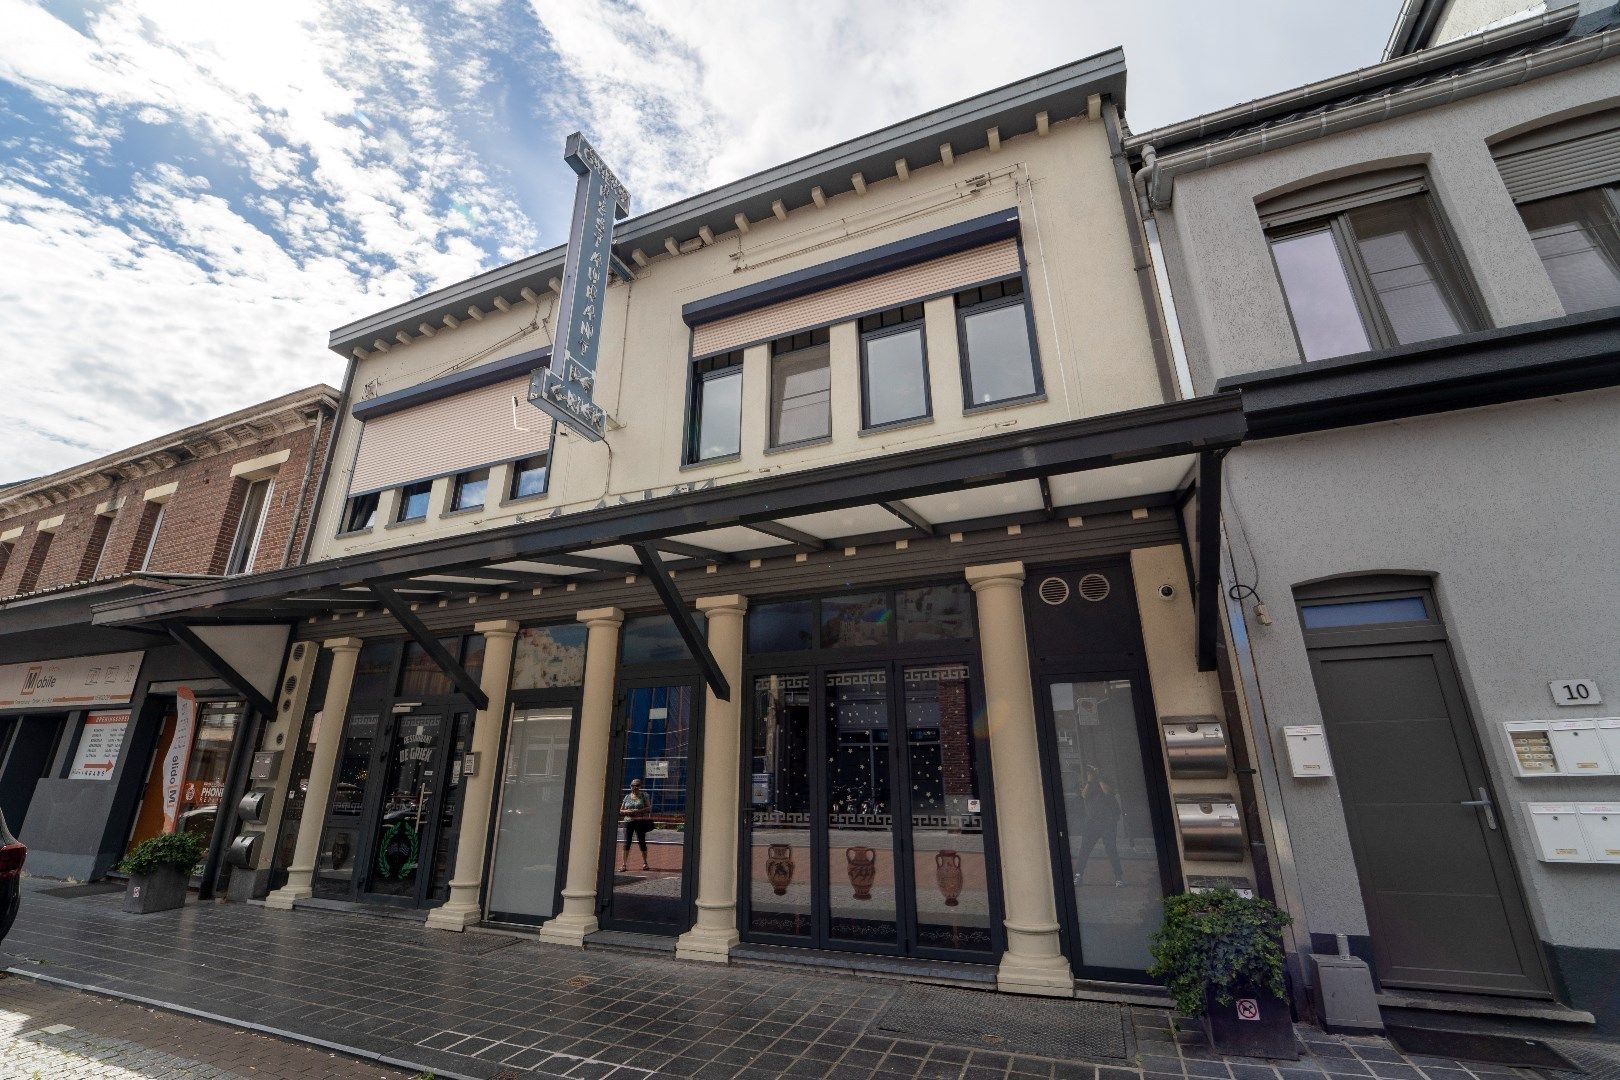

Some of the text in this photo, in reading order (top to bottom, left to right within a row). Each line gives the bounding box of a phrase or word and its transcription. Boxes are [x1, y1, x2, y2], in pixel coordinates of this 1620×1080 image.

[579, 184, 610, 355] RESTAURANT
[24, 671, 57, 690] Mobile
[1563, 683, 1590, 700] 10
[400, 747, 433, 762] DE GRIEK
